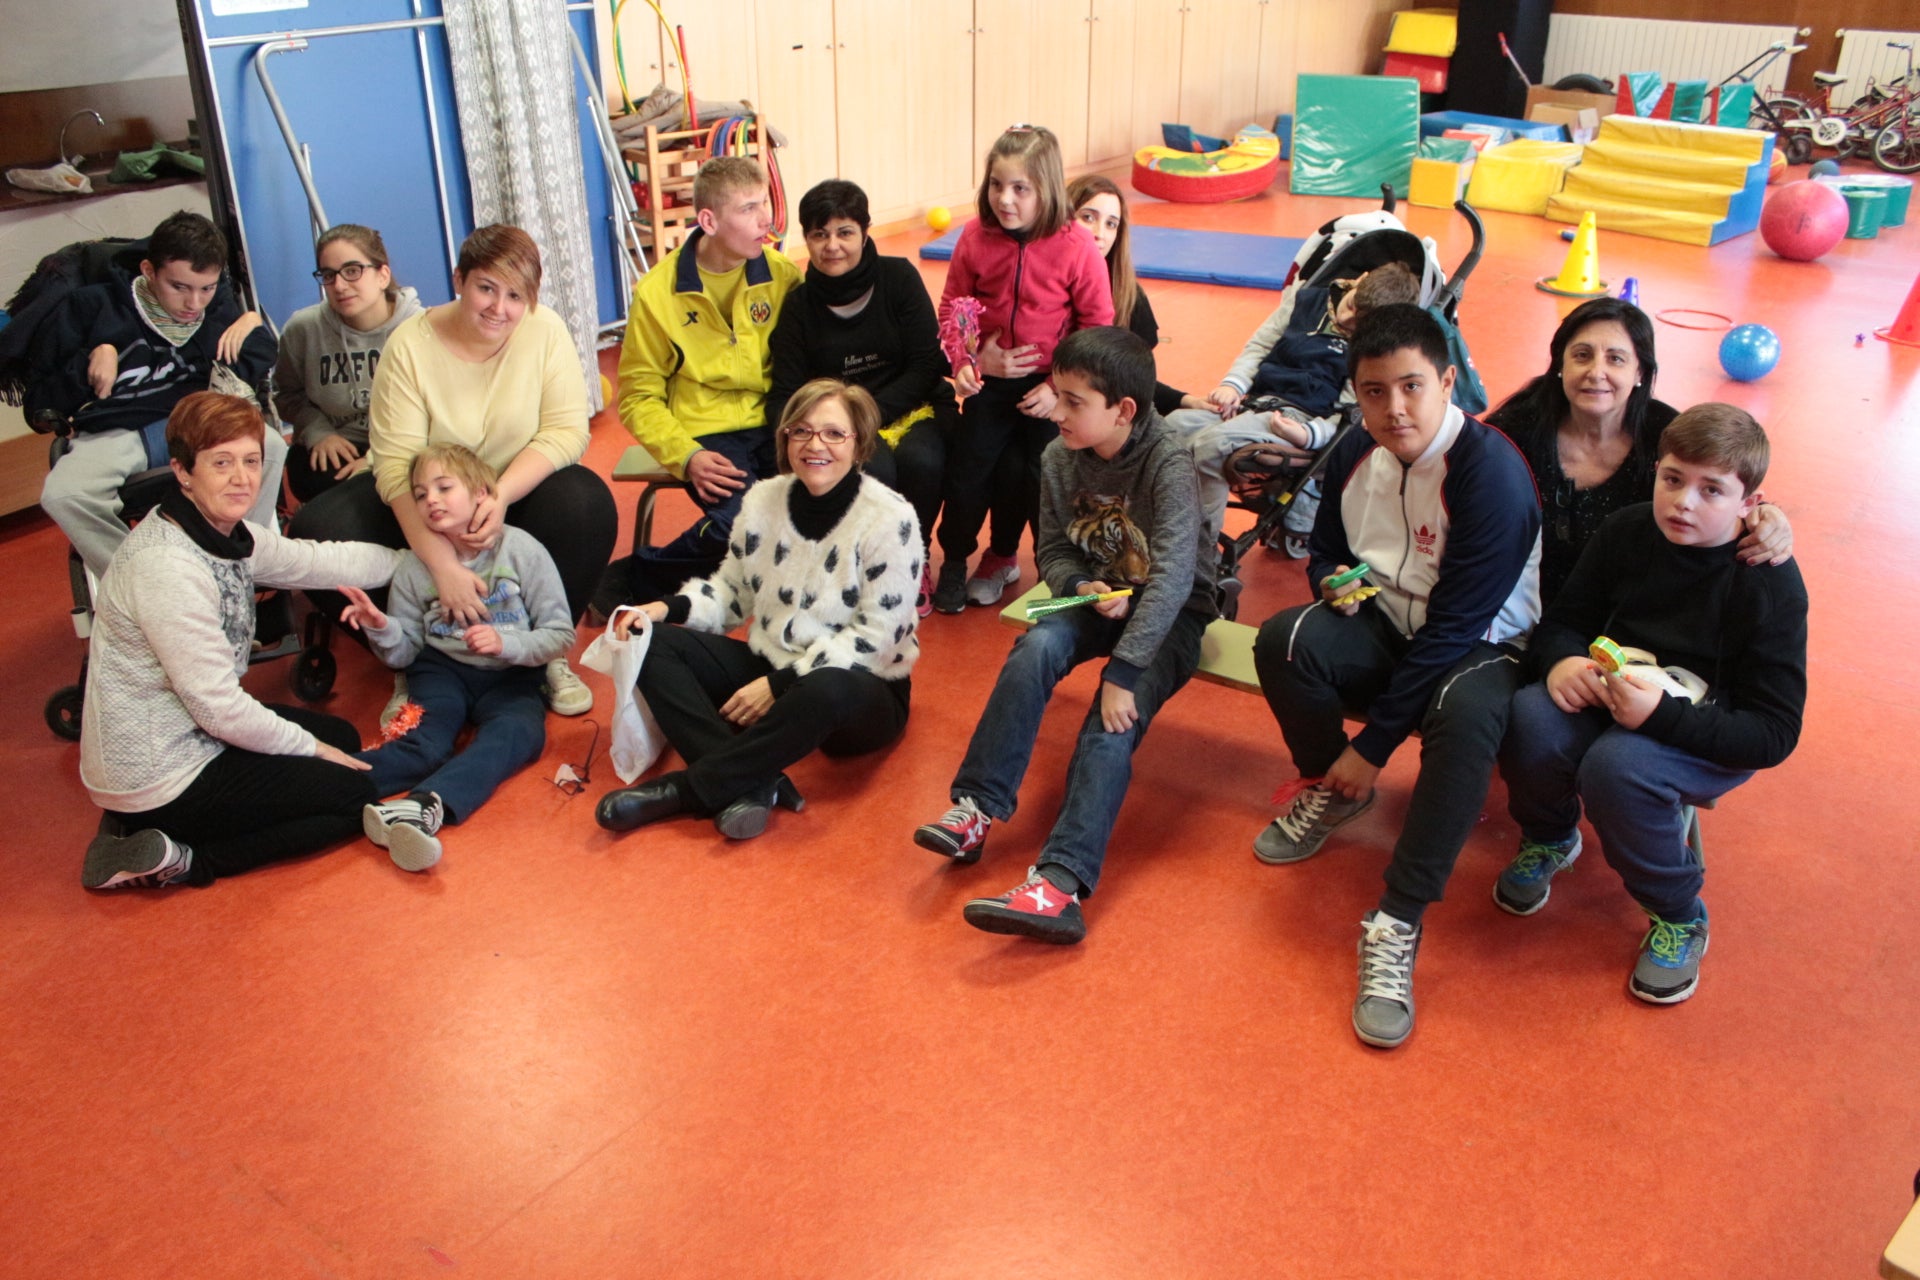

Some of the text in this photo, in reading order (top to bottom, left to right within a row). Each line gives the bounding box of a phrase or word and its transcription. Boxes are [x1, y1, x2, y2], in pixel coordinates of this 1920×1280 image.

[320, 349, 381, 387] OXFO
[844, 353, 878, 369] follow me
